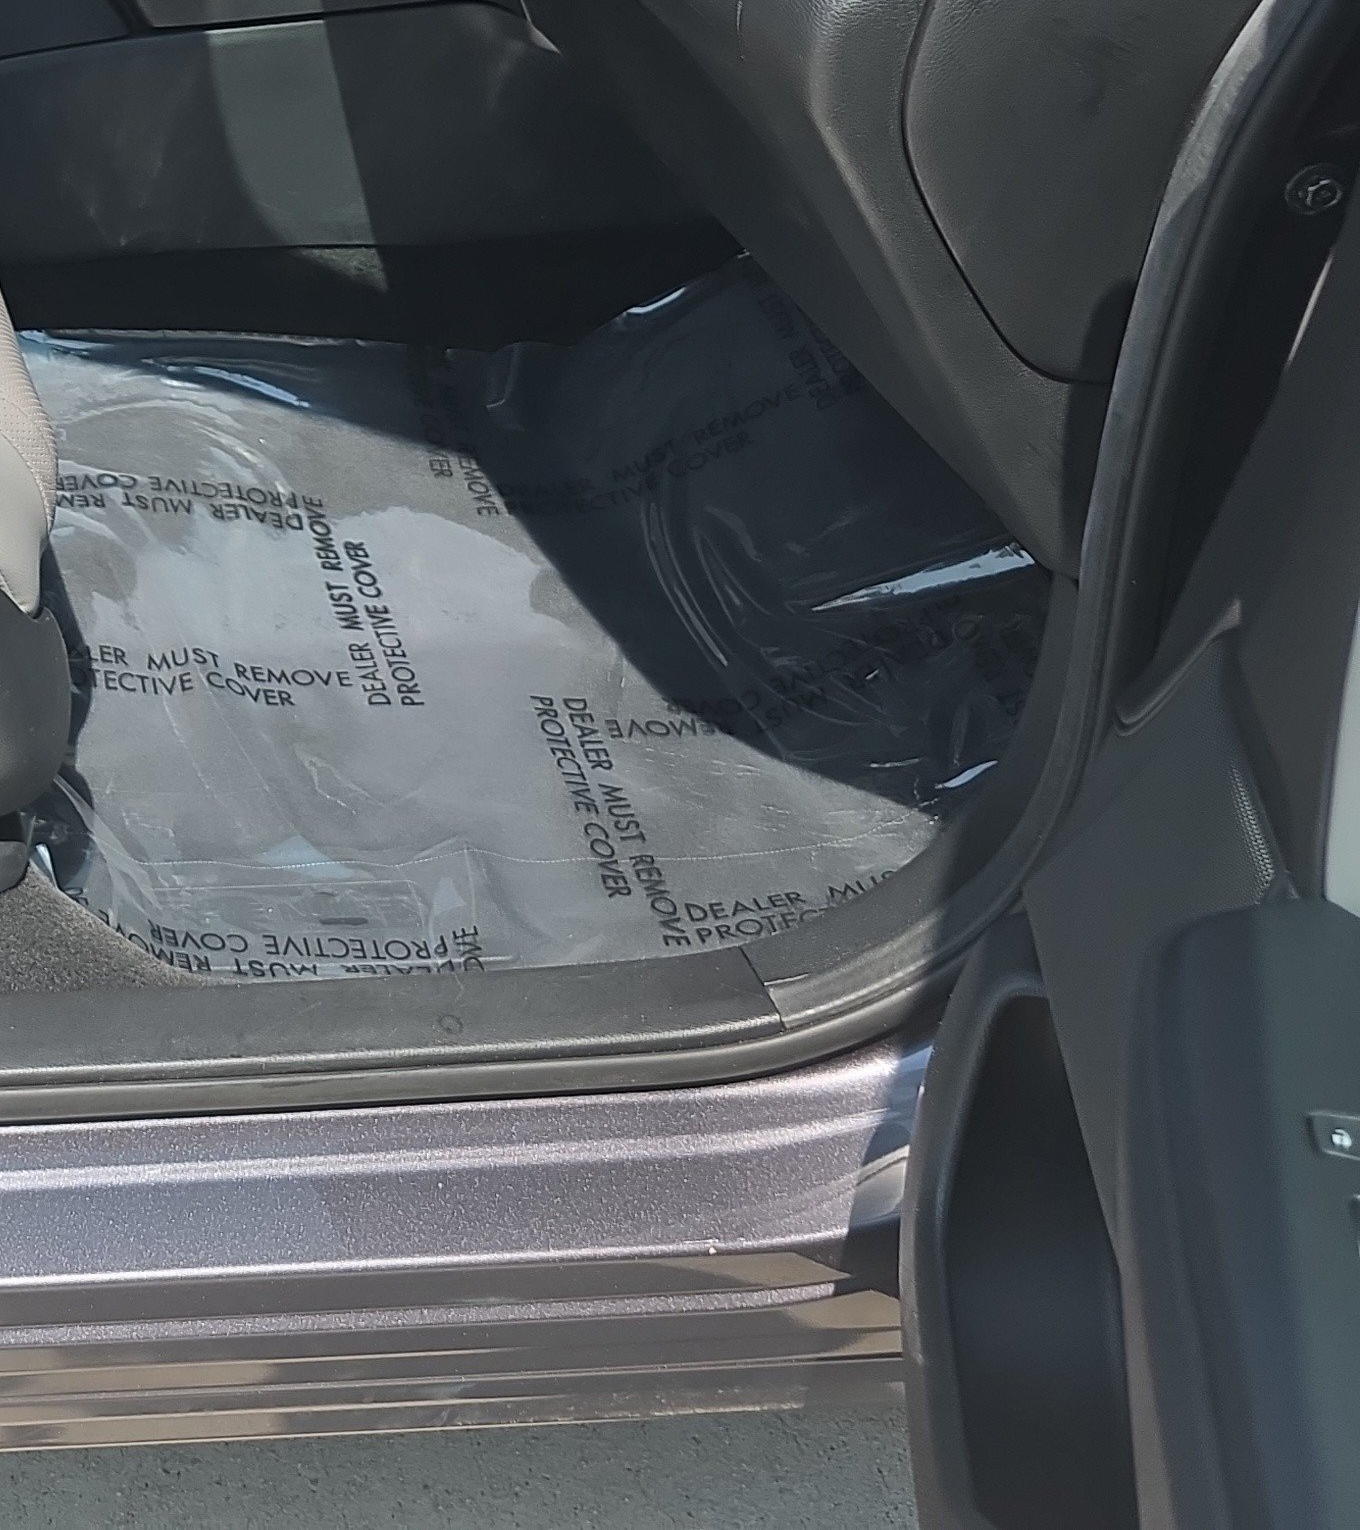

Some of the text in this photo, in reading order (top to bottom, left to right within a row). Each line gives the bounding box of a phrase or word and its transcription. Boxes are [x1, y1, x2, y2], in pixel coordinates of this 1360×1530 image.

[121, 492, 192, 514] MUST
[148, 475, 299, 510] PROTECTIVE
[210, 502, 305, 531] DEALER
[302, 494, 392, 706] DEALER MUST REMOVE
[343, 539, 425, 707] PROTECTIVE COVER
[147, 647, 219, 670] MUST
[233, 661, 354, 688] REMOVE
[206, 670, 296, 707] COVER
[529, 694, 632, 898] PROTECTIVE COVER
[562, 697, 692, 947] DEALER MUST REMOVE
[684, 891, 807, 922] DEALER
[147, 919, 449, 961] PROTECTIVE COVER
